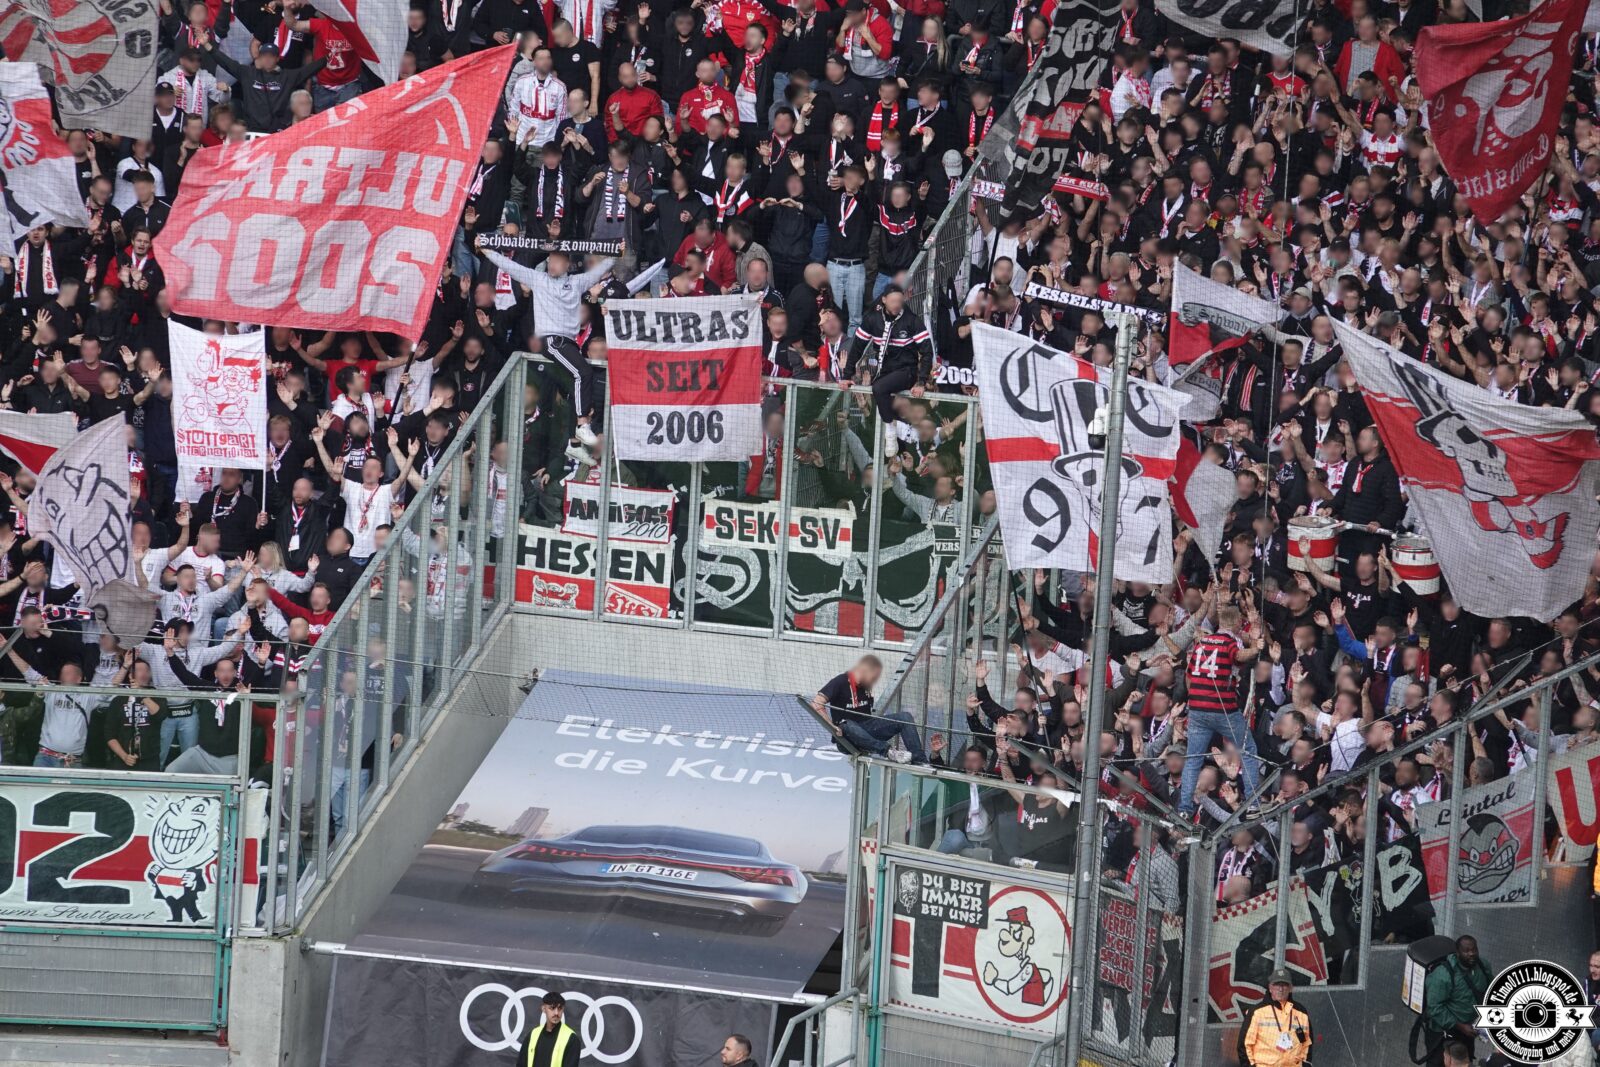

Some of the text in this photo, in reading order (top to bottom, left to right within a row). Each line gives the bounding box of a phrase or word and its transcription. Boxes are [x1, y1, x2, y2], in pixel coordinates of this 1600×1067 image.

[480, 233, 621, 255] Schwaben Kompanie
[1025, 281, 1147, 318] KESSELSTADT
[609, 309, 750, 343] ULTRAS
[646, 359, 724, 393] SEIT
[646, 410, 724, 445] 2006
[622, 521, 668, 538] 2010
[715, 506, 840, 550] SEK SV
[1191, 645, 1219, 679] 14
[554, 749, 648, 775] die
[1435, 781, 1516, 828] Lintal
[610, 864, 628, 873] IN
[635, 865, 655, 873] GT
[922, 873, 984, 896] DU BIST
[922, 887, 983, 912] IMMER
[44, 905, 155, 923] Stuttgart
[921, 903, 983, 924] BEI UNS!
